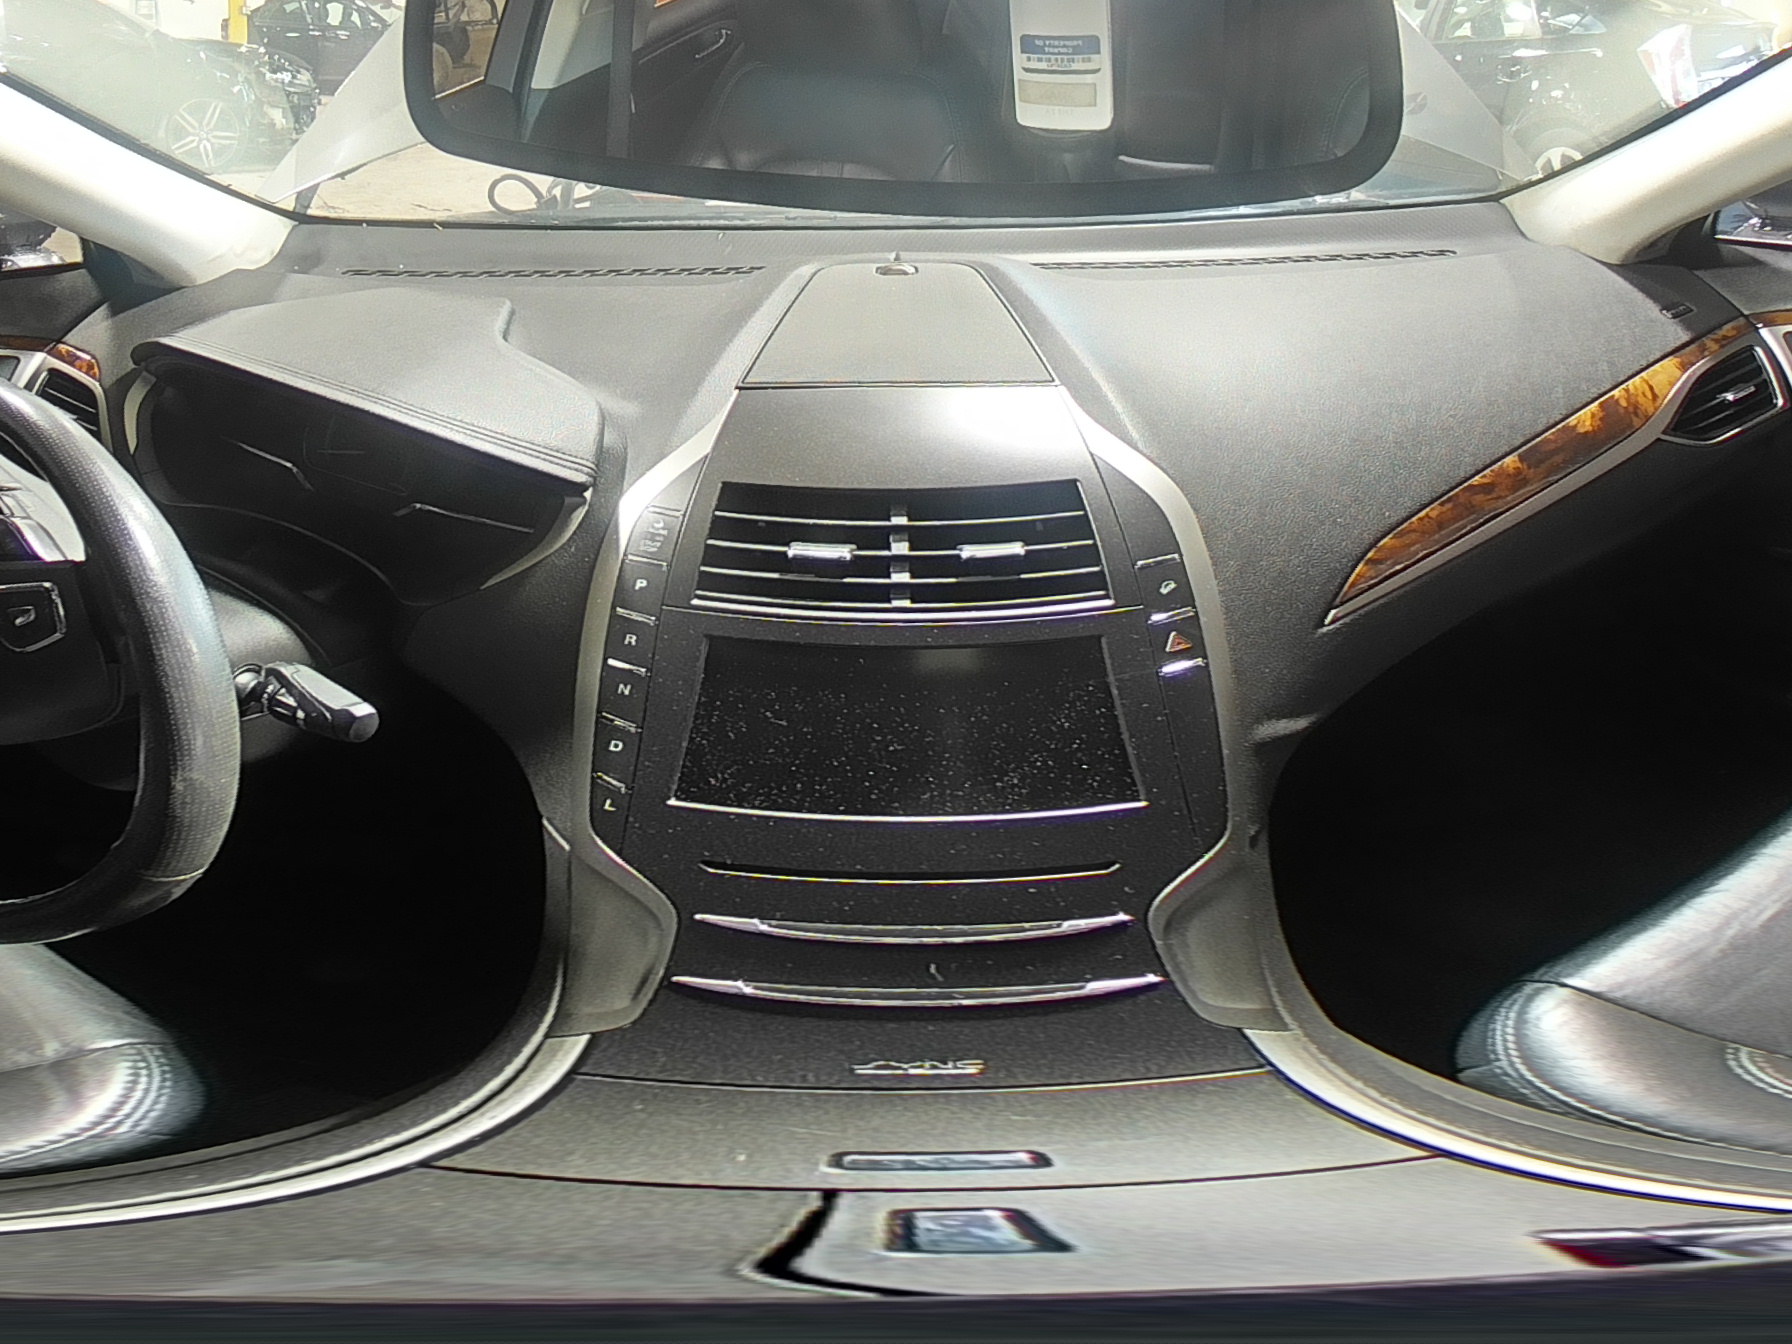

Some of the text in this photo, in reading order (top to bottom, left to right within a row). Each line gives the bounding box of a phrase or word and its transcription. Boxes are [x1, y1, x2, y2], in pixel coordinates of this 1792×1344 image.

[635, 578, 648, 591] P
[624, 634, 637, 646] R
[617, 684, 631, 695] N
[609, 740, 624, 752] D
[603, 797, 617, 811] L
